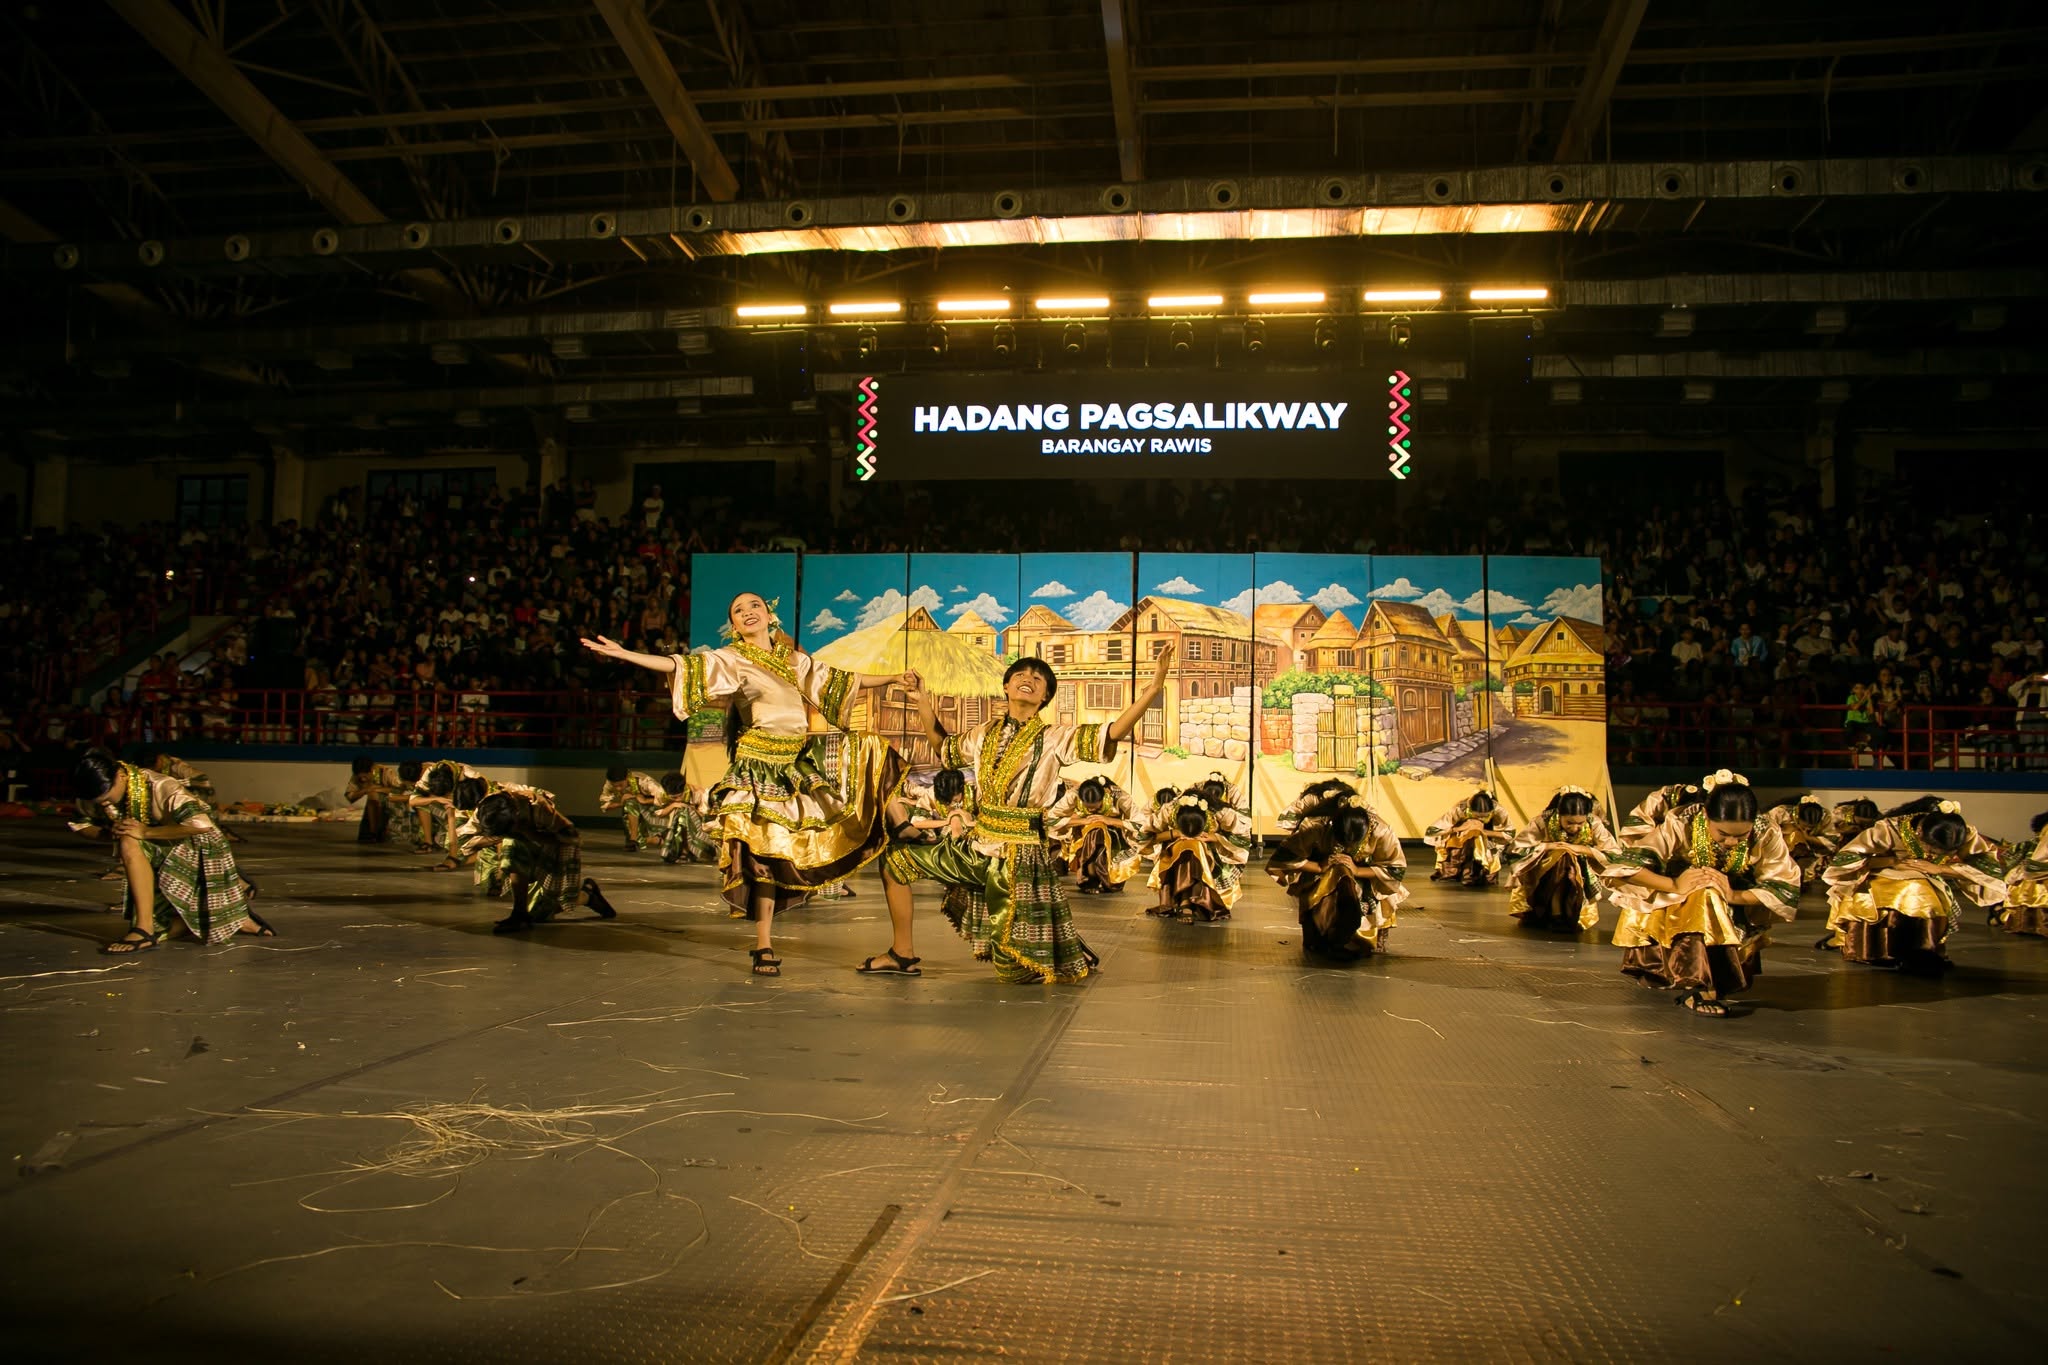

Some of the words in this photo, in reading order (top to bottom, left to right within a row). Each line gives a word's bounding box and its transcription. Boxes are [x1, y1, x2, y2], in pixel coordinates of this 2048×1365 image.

[915, 404, 1069, 432] HADANG
[1081, 402, 1348, 429] PAGSALIKWAY
[1042, 438, 1145, 453] BARANGAY
[1151, 438, 1212, 452] RAWIS
